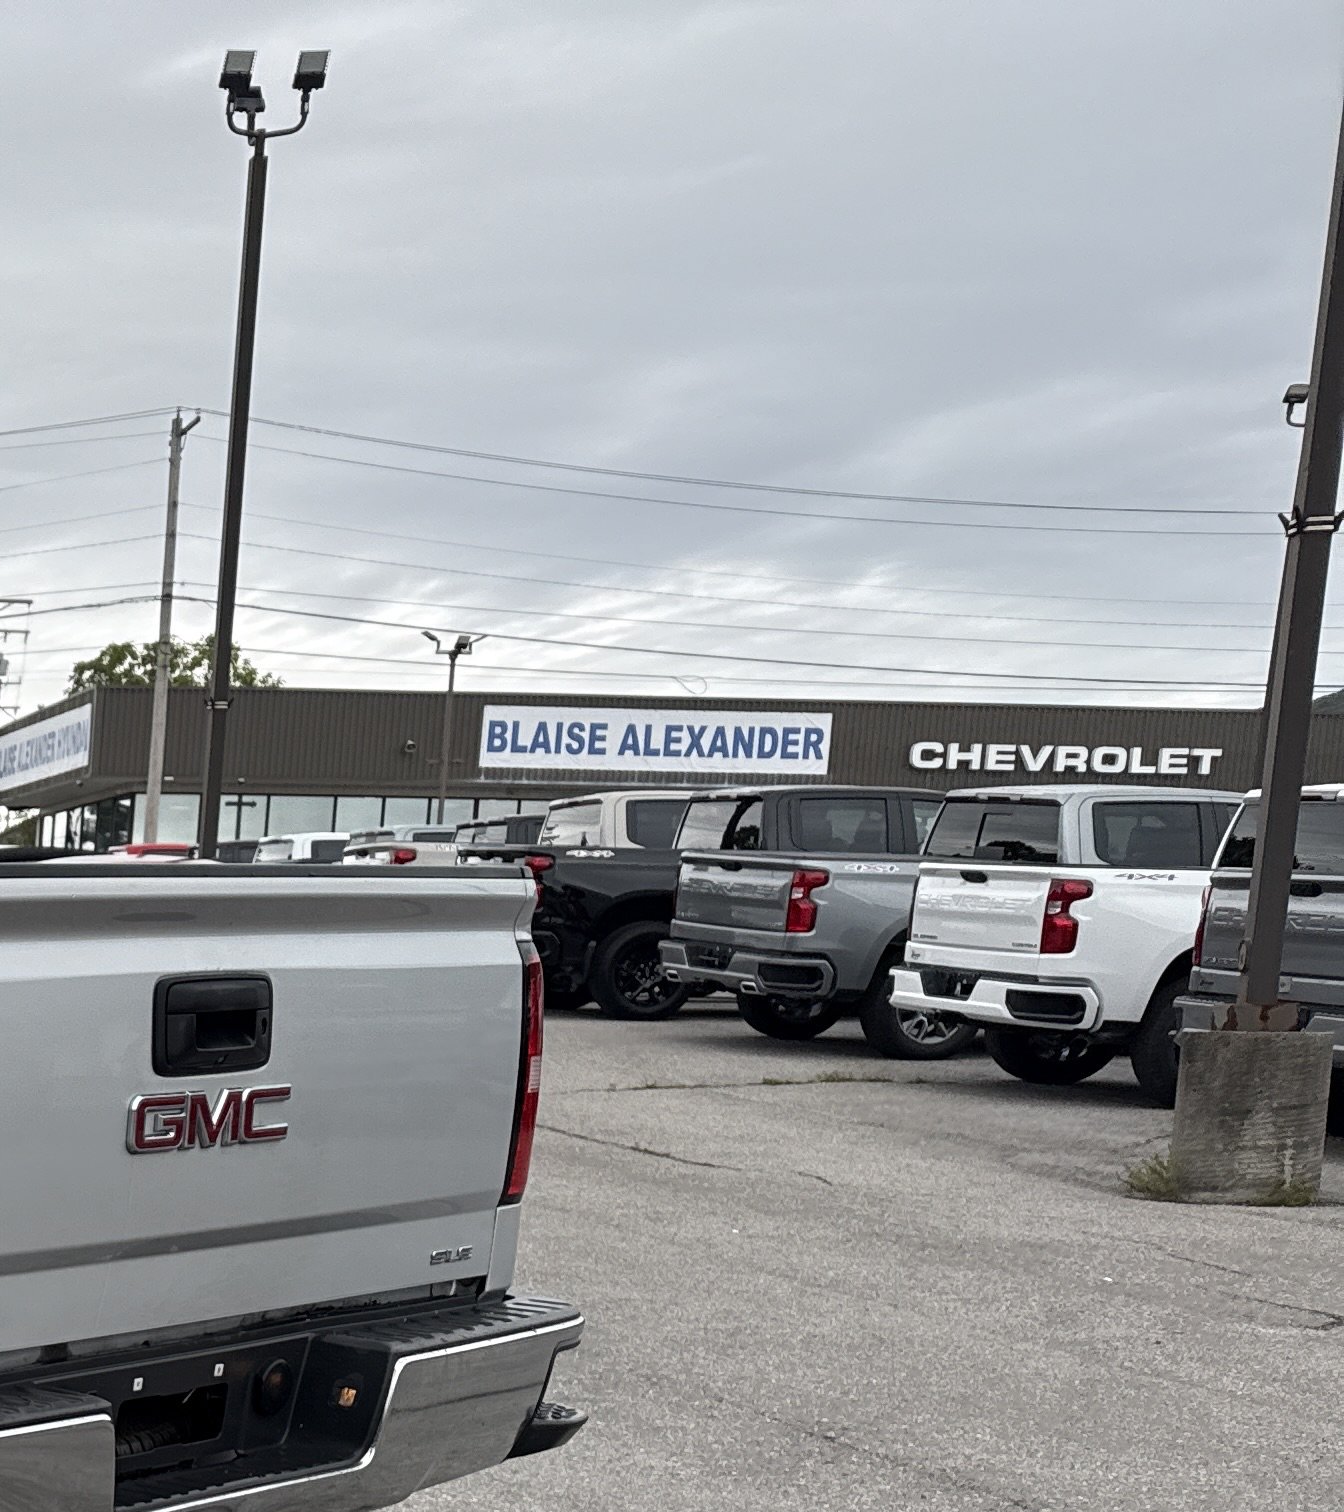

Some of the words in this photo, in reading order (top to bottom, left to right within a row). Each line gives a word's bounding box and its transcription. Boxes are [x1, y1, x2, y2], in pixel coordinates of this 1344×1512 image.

[487, 719, 608, 755] BLAISE
[618, 723, 825, 761] ALEXANDER
[909, 741, 1223, 776] CHEVROLET
[126, 1083, 292, 1155] GMC
[430, 1245, 473, 1266] SLE
